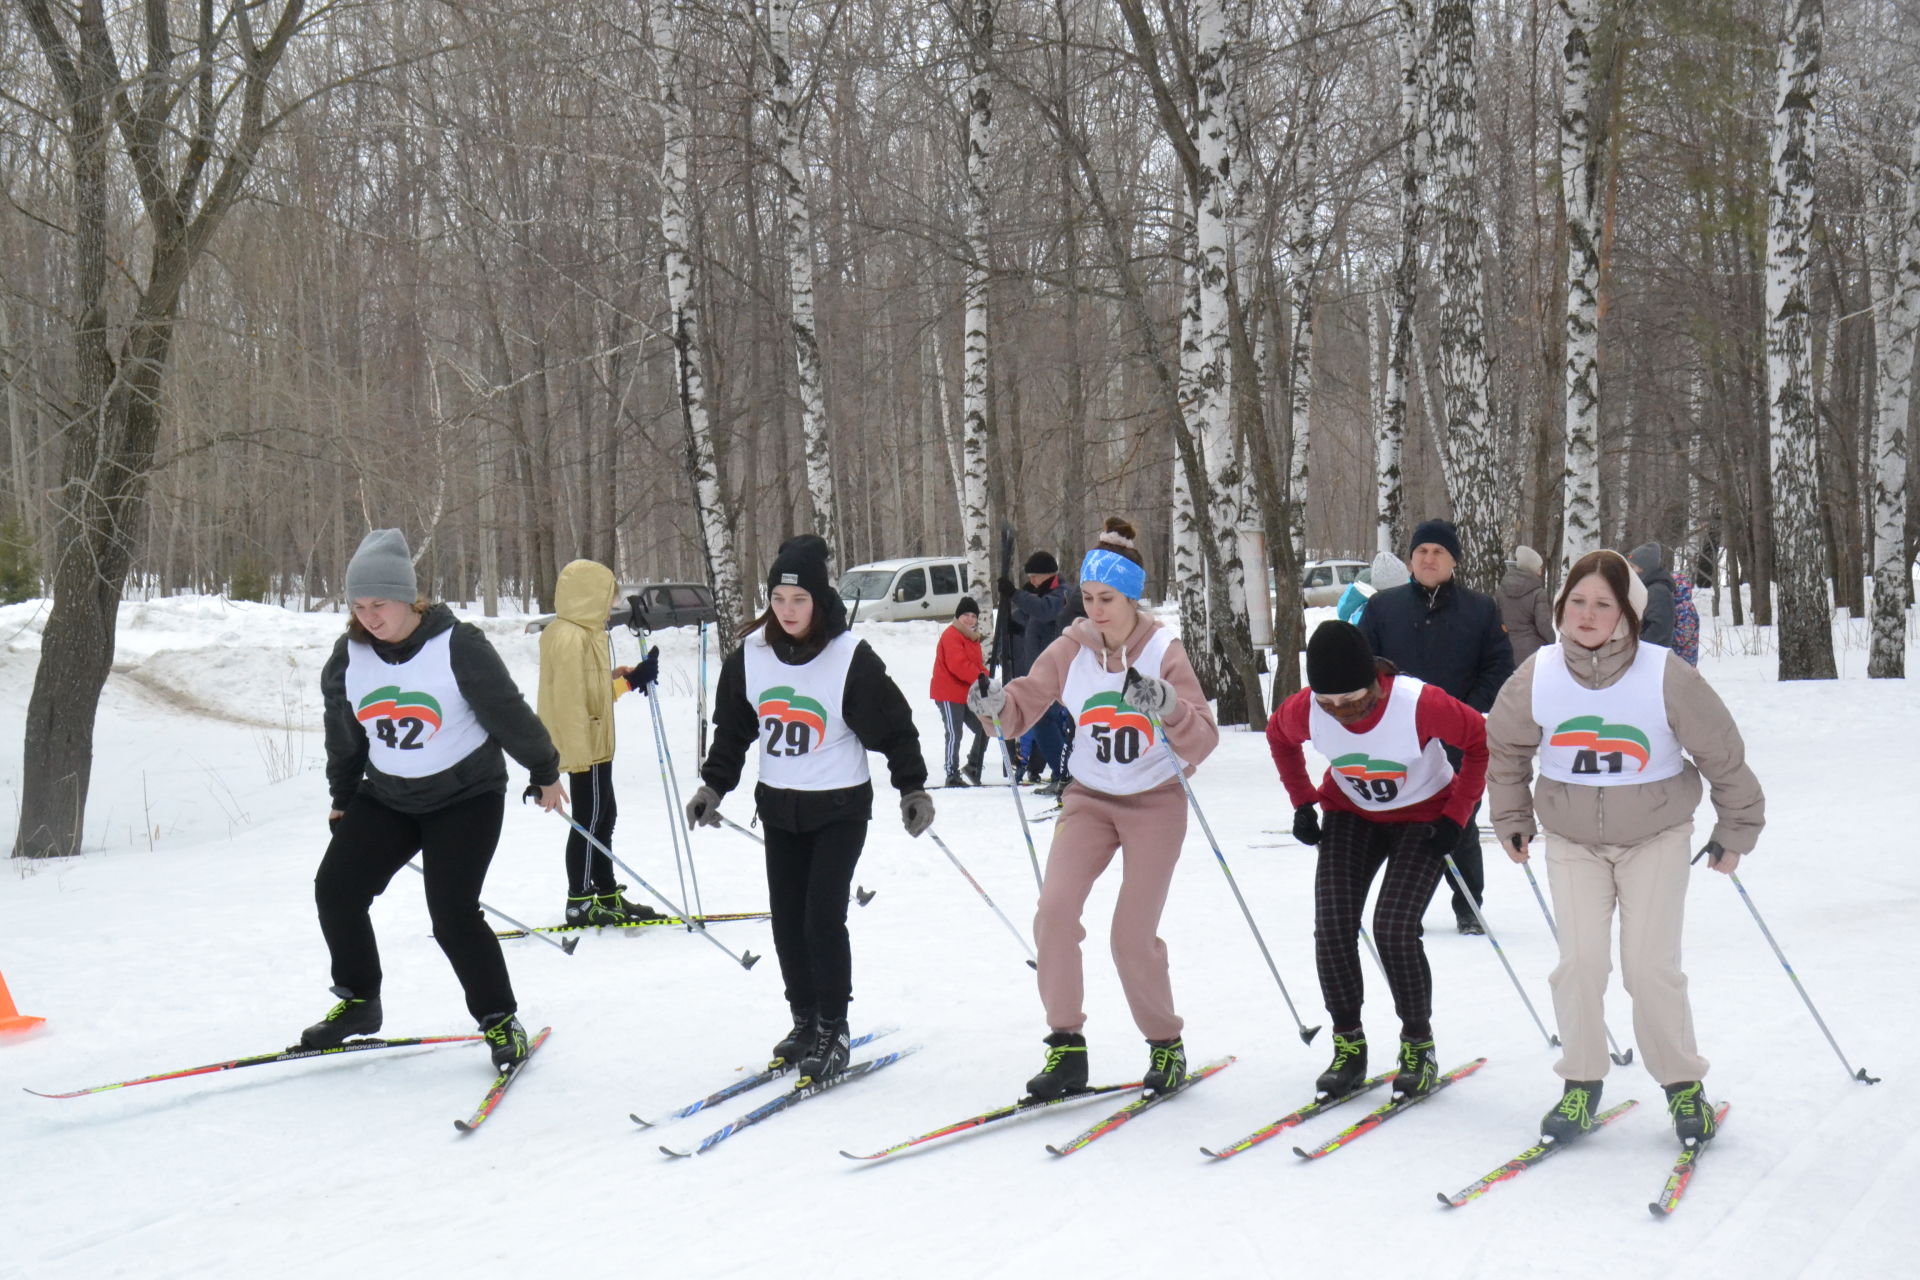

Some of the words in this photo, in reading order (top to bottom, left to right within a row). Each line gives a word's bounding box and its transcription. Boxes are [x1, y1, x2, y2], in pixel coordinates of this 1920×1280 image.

[377, 716, 423, 749] 42
[766, 717, 809, 757] 29
[1090, 724, 1139, 763] 50
[1571, 751, 1623, 775] 41
[1344, 776, 1398, 804] 39
